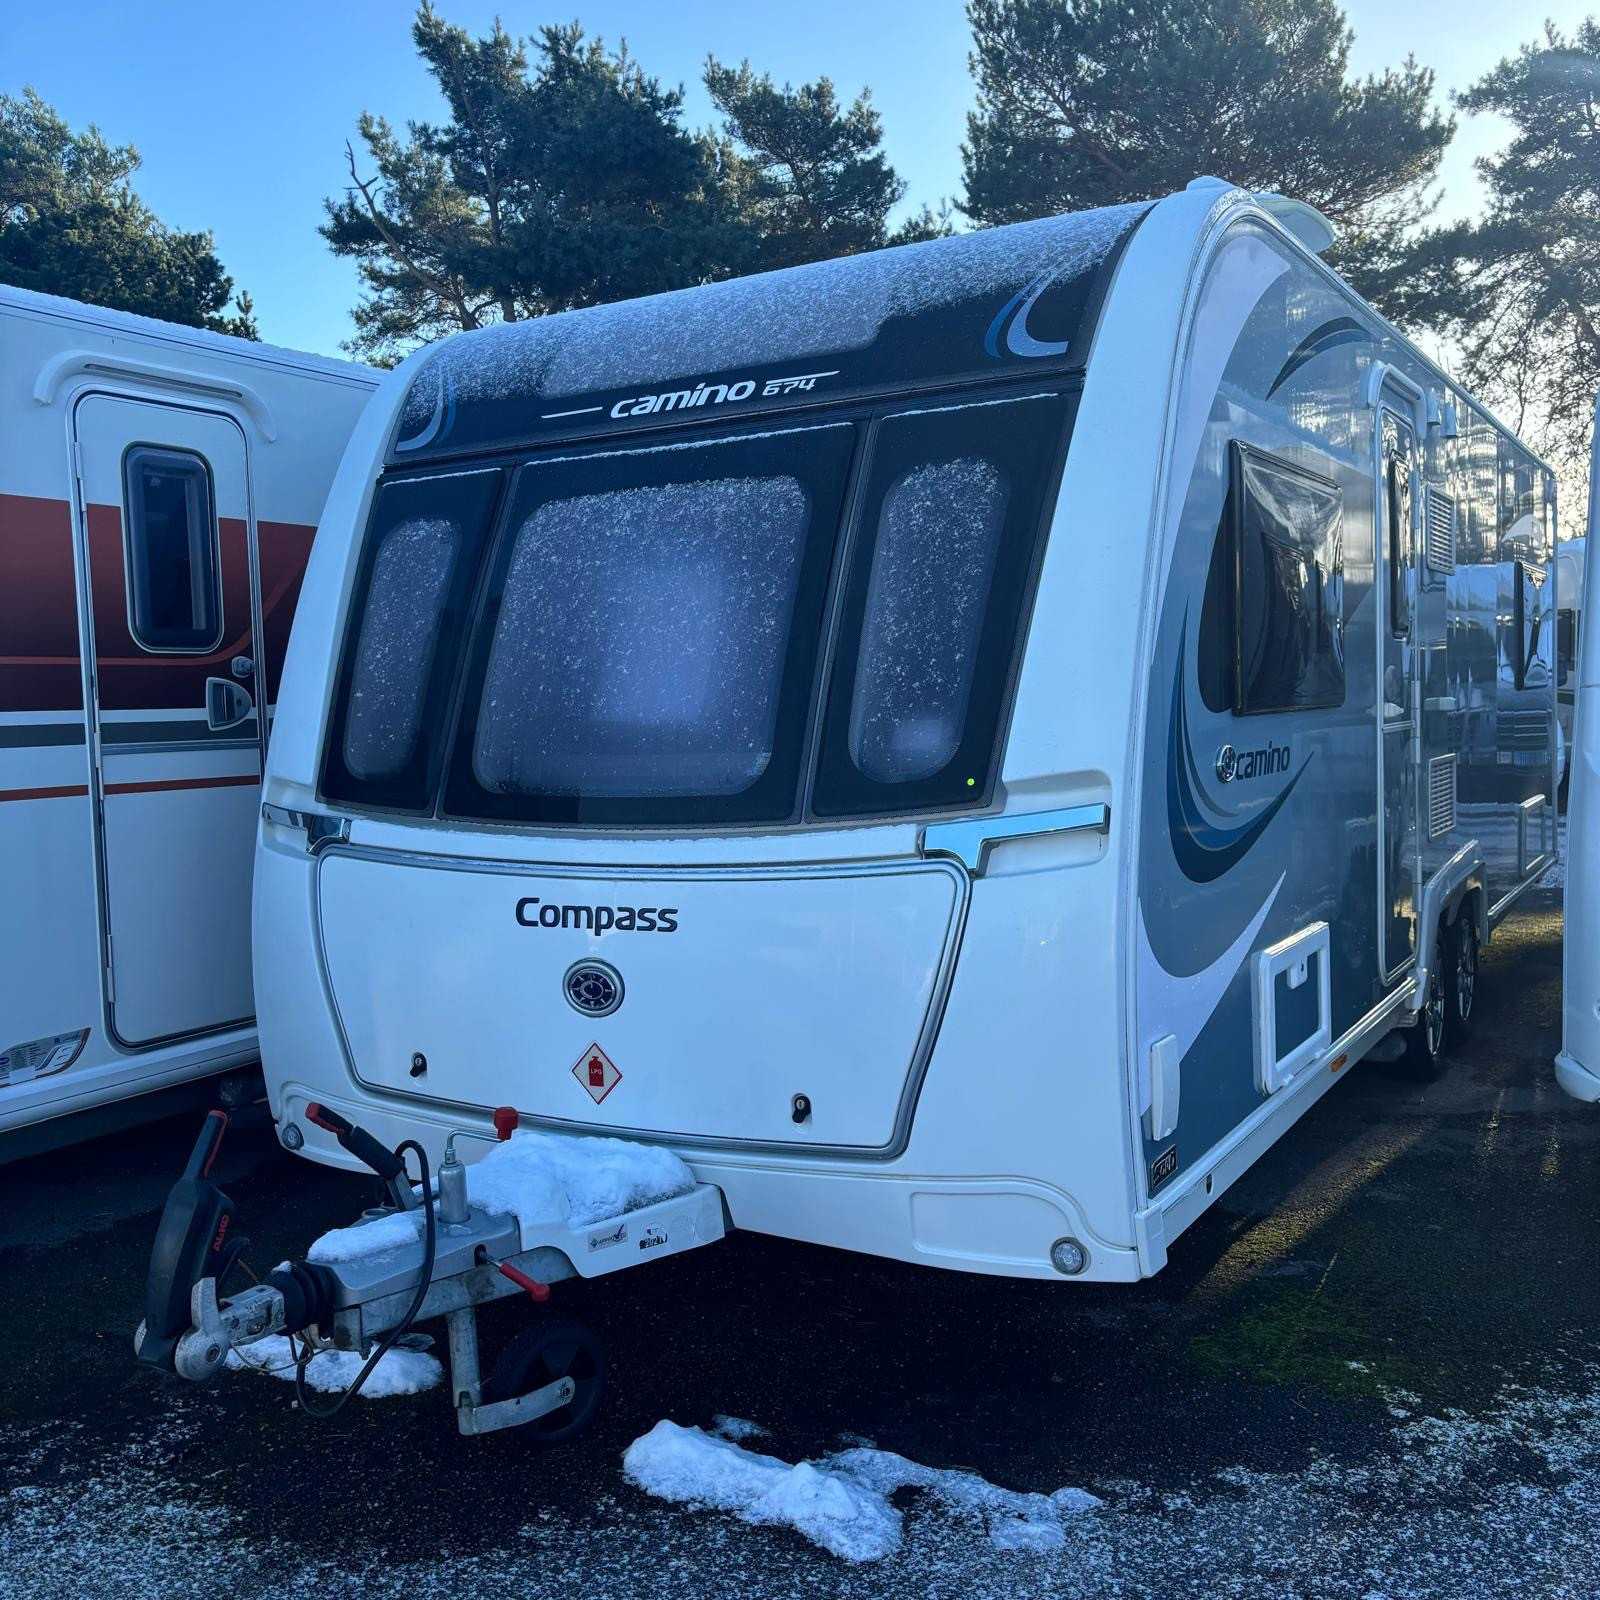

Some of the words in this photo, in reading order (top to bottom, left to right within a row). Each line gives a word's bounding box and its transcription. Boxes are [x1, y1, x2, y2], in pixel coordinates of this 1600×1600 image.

[611, 380, 756, 418] camino
[762, 378, 816, 397] 674
[1236, 740, 1290, 780] camino
[516, 897, 679, 936] Compass
